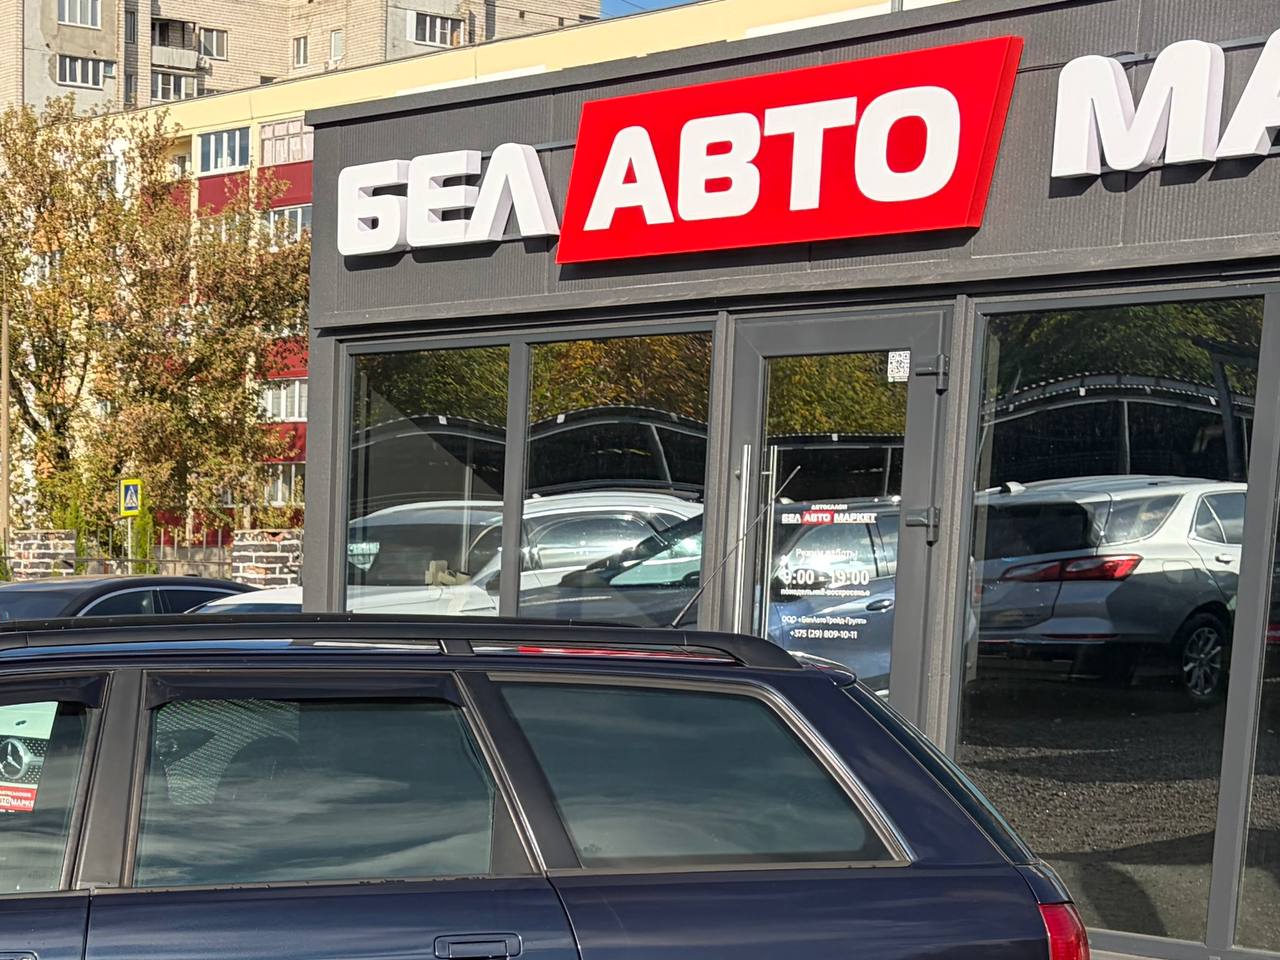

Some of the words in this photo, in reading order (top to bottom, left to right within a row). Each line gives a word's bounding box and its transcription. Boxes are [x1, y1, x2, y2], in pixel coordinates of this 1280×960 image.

[337, 143, 559, 256] БЕЛ
[583, 85, 961, 231] АВТО
[803, 513, 832, 523] АВТО
[833, 513, 877, 523] МАРКЕТ
[783, 569, 815, 584] 9:00
[831, 569, 870, 585] 19:00
